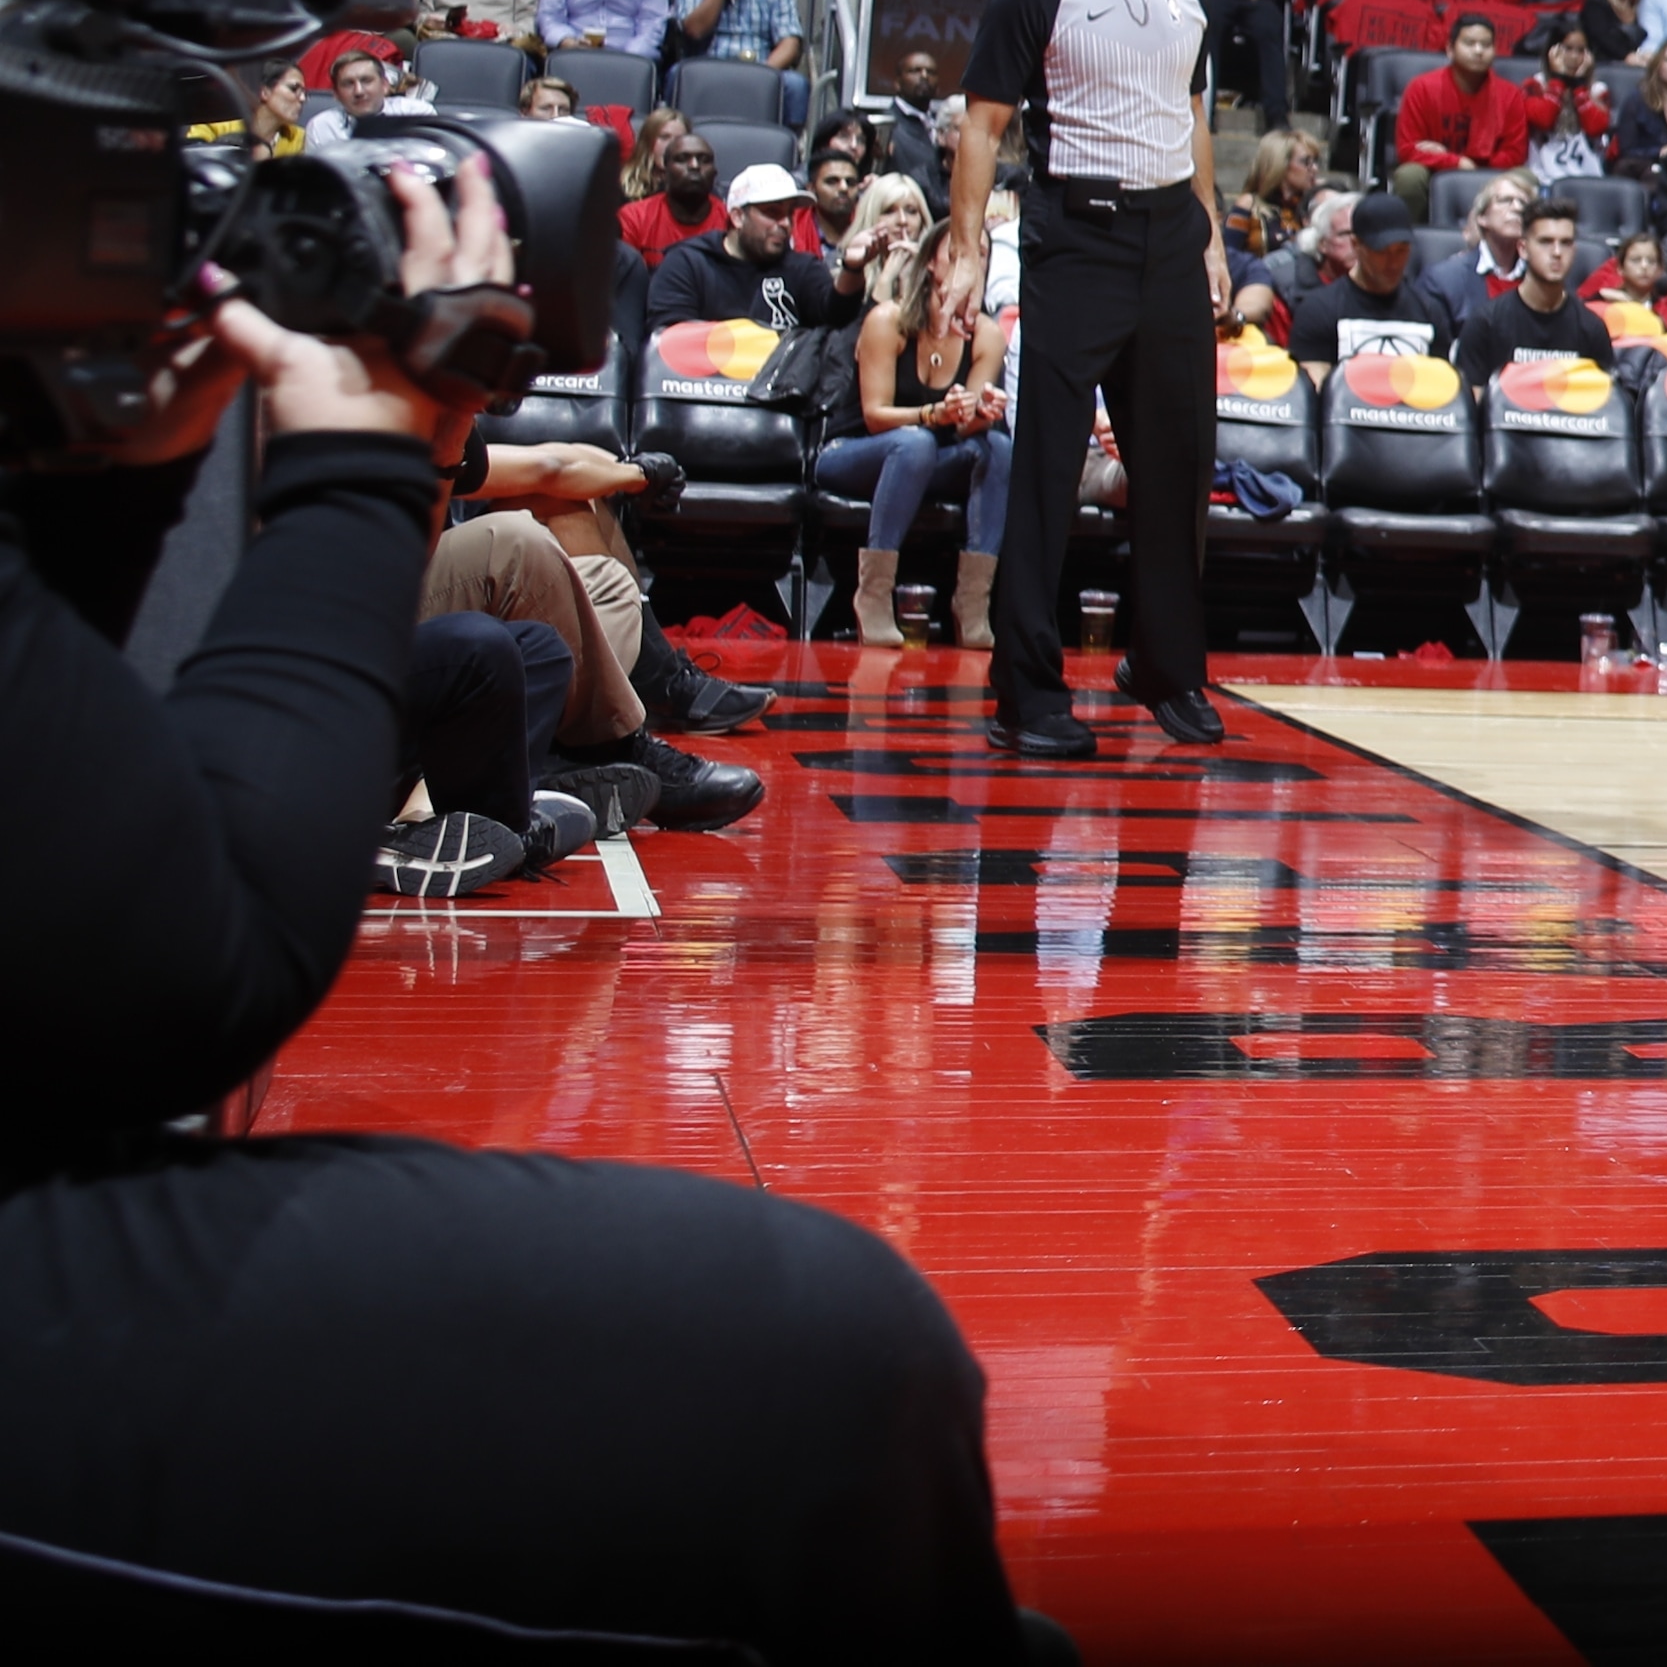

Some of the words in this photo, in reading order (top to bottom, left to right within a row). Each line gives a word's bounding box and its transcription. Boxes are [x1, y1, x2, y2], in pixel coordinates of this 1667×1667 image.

[1555, 138, 1584, 168] 24
[661, 377, 748, 398] masterc
[1350, 405, 1456, 430] mastercard
[1503, 409, 1609, 433] mastercard
